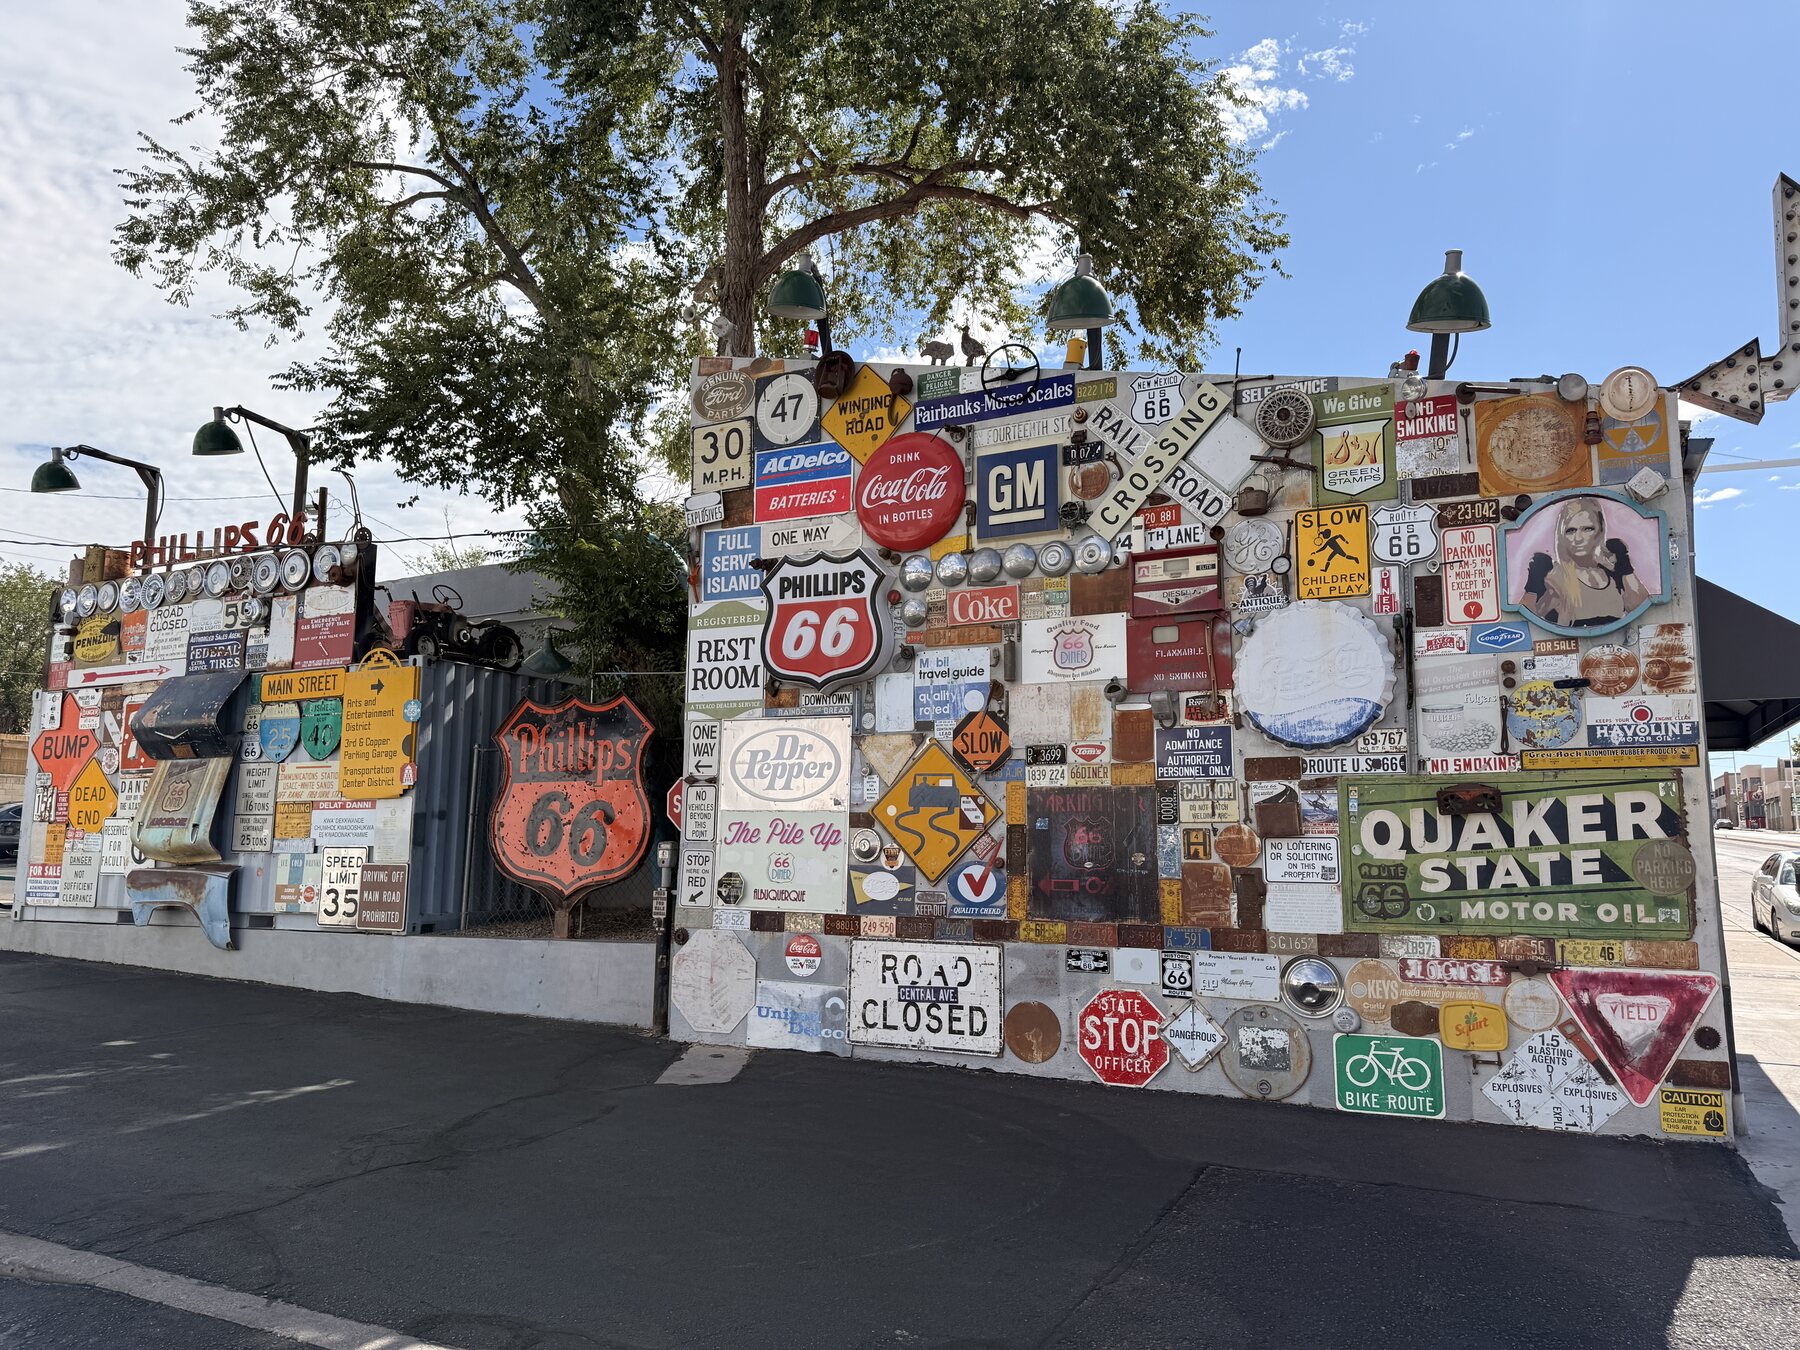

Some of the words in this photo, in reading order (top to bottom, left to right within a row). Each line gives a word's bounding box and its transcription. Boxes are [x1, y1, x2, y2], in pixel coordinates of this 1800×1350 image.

[770, 393, 804, 423] 47
[1144, 398, 1170, 420] 66
[1323, 398, 1345, 414] We
[1349, 395, 1382, 410] Give
[846, 416, 884, 436] ROAD
[1396, 413, 1456, 438] SMOKING
[701, 427, 744, 464] 30
[890, 452, 920, 465] DRINK
[1091, 406, 1142, 456] RAIL
[1164, 466, 1224, 518] ROAD
[1100, 392, 1218, 525] CROSSING
[1328, 468, 1380, 478] GREEN
[862, 465, 952, 509] Coca-Cola
[988, 459, 1045, 512] GM
[769, 490, 837, 511] BATTERIES
[879, 514, 889, 525] IN
[892, 508, 933, 522] BOTTLES
[1302, 508, 1363, 528] SLOW
[1457, 502, 1497, 520] 23-042
[130, 521, 259, 568] PHILLIPS
[266, 512, 308, 546] 66
[718, 532, 752, 551] FULL
[772, 530, 798, 547] ONE
[802, 526, 830, 542] WAY
[1460, 530, 1476, 544] NO
[1389, 534, 1420, 556] 66
[1447, 544, 1492, 560] PARKING
[779, 570, 866, 600] PHILLIPS
[1302, 572, 1366, 586] CHILDREN
[1452, 580, 1478, 591] EXCEPT
[1482, 580, 1491, 589] BY
[1306, 586, 1322, 597] AT
[1329, 584, 1364, 595] PLAY
[1459, 590, 1484, 600] PERMIT
[156, 607, 184, 620] ROAD
[952, 592, 1013, 622] Coke
[310, 616, 341, 624] EMERGENCY
[696, 614, 761, 627] REGISTERED
[782, 606, 860, 660] 66
[696, 637, 756, 663] REST
[1536, 642, 1552, 652] FOR
[1554, 640, 1577, 651] SALE
[210, 657, 240, 669] TIRES
[691, 664, 761, 690] ROOM
[919, 668, 950, 680] travel
[952, 666, 985, 682] guide
[268, 678, 293, 696] MAIN
[298, 674, 338, 693] STREET
[347, 699, 362, 708] Arts
[364, 697, 376, 706] and
[346, 708, 394, 720] Entertainment
[246, 720, 258, 730] 66
[692, 725, 718, 740] ONE
[1596, 722, 1692, 738] HAVOLINE
[1186, 728, 1200, 739] NO
[42, 735, 90, 760] BUMP
[692, 742, 716, 757] WAY
[776, 734, 814, 761] Dr
[960, 731, 1002, 754] SLOW
[1164, 738, 1223, 751] ADMITTANCE
[244, 748, 256, 757] 66
[513, 721, 632, 787] Phillips
[1529, 750, 1582, 759] Grey-Rock
[1620, 748, 1644, 756] RUBBER
[1167, 755, 1221, 766] AUTHORIZED
[1431, 758, 1449, 772] NO
[1454, 756, 1517, 772] SMOKING
[246, 768, 271, 777] WEIGHT
[344, 765, 394, 777] Transportation
[741, 750, 833, 791] Pepper
[1158, 766, 1205, 778] PERSONNEL
[1209, 766, 1231, 776] ONLY
[248, 780, 266, 788] LIMIT
[342, 779, 366, 788] Center
[368, 777, 394, 787] District
[75, 787, 106, 802] DEAD
[696, 790, 707, 801] NO
[245, 800, 254, 811] 16
[254, 802, 269, 811] TONS
[688, 804, 714, 812] VEHICLES
[77, 810, 100, 825] END
[1360, 790, 1669, 860] QUAKER
[526, 790, 616, 867] 66
[692, 830, 708, 838] POINT
[724, 821, 761, 846] The
[766, 818, 805, 845] Pile
[810, 822, 842, 851] Up
[110, 841, 122, 851] FOR
[241, 835, 251, 846] 25
[252, 838, 267, 846] TONS
[1270, 842, 1282, 850] NO
[1287, 842, 1332, 851] LOITERING
[70, 856, 92, 864] DANGER
[326, 856, 364, 868] SPEED
[686, 855, 710, 866] STOP
[774, 856, 790, 868] 66
[1286, 852, 1334, 861] SOLICITING
[29, 866, 43, 876] FOR
[44, 865, 61, 876] SALE
[1300, 862, 1316, 870] THIS
[1418, 848, 1604, 893] STATE
[74, 870, 85, 878] NOT
[328, 872, 358, 884] LIMIT
[363, 871, 388, 882] DRIVING
[392, 871, 405, 882] OFF
[687, 877, 706, 888] RED
[323, 888, 358, 918] 35
[363, 891, 380, 902] MAIN
[383, 891, 401, 902] ROAD
[362, 910, 400, 922] PROHIBITED
[1461, 900, 1580, 922] MOTOR
[1597, 902, 1657, 924] OIL
[1168, 970, 1188, 985] 66
[1367, 980, 1399, 1000] KEYS
[1400, 987, 1420, 997] made
[1420, 988, 1440, 998] while
[1442, 990, 1454, 1001] you
[1455, 990, 1479, 1000] watch
[861, 999, 988, 1037] CLOSED
[1609, 1004, 1658, 1021] YIELD
[1084, 1016, 1160, 1054] STOP
[1169, 1028, 1217, 1043] DANGEROUS
[1531, 1054, 1568, 1066] AGENTS
[1492, 1082, 1543, 1094] EXPLOSIVES
[1346, 1091, 1380, 1108] BIKE
[1388, 1094, 1435, 1113] ROUTE
[1662, 1091, 1722, 1106] CAUTION
[1663, 1112, 1699, 1120] PROTECTION
